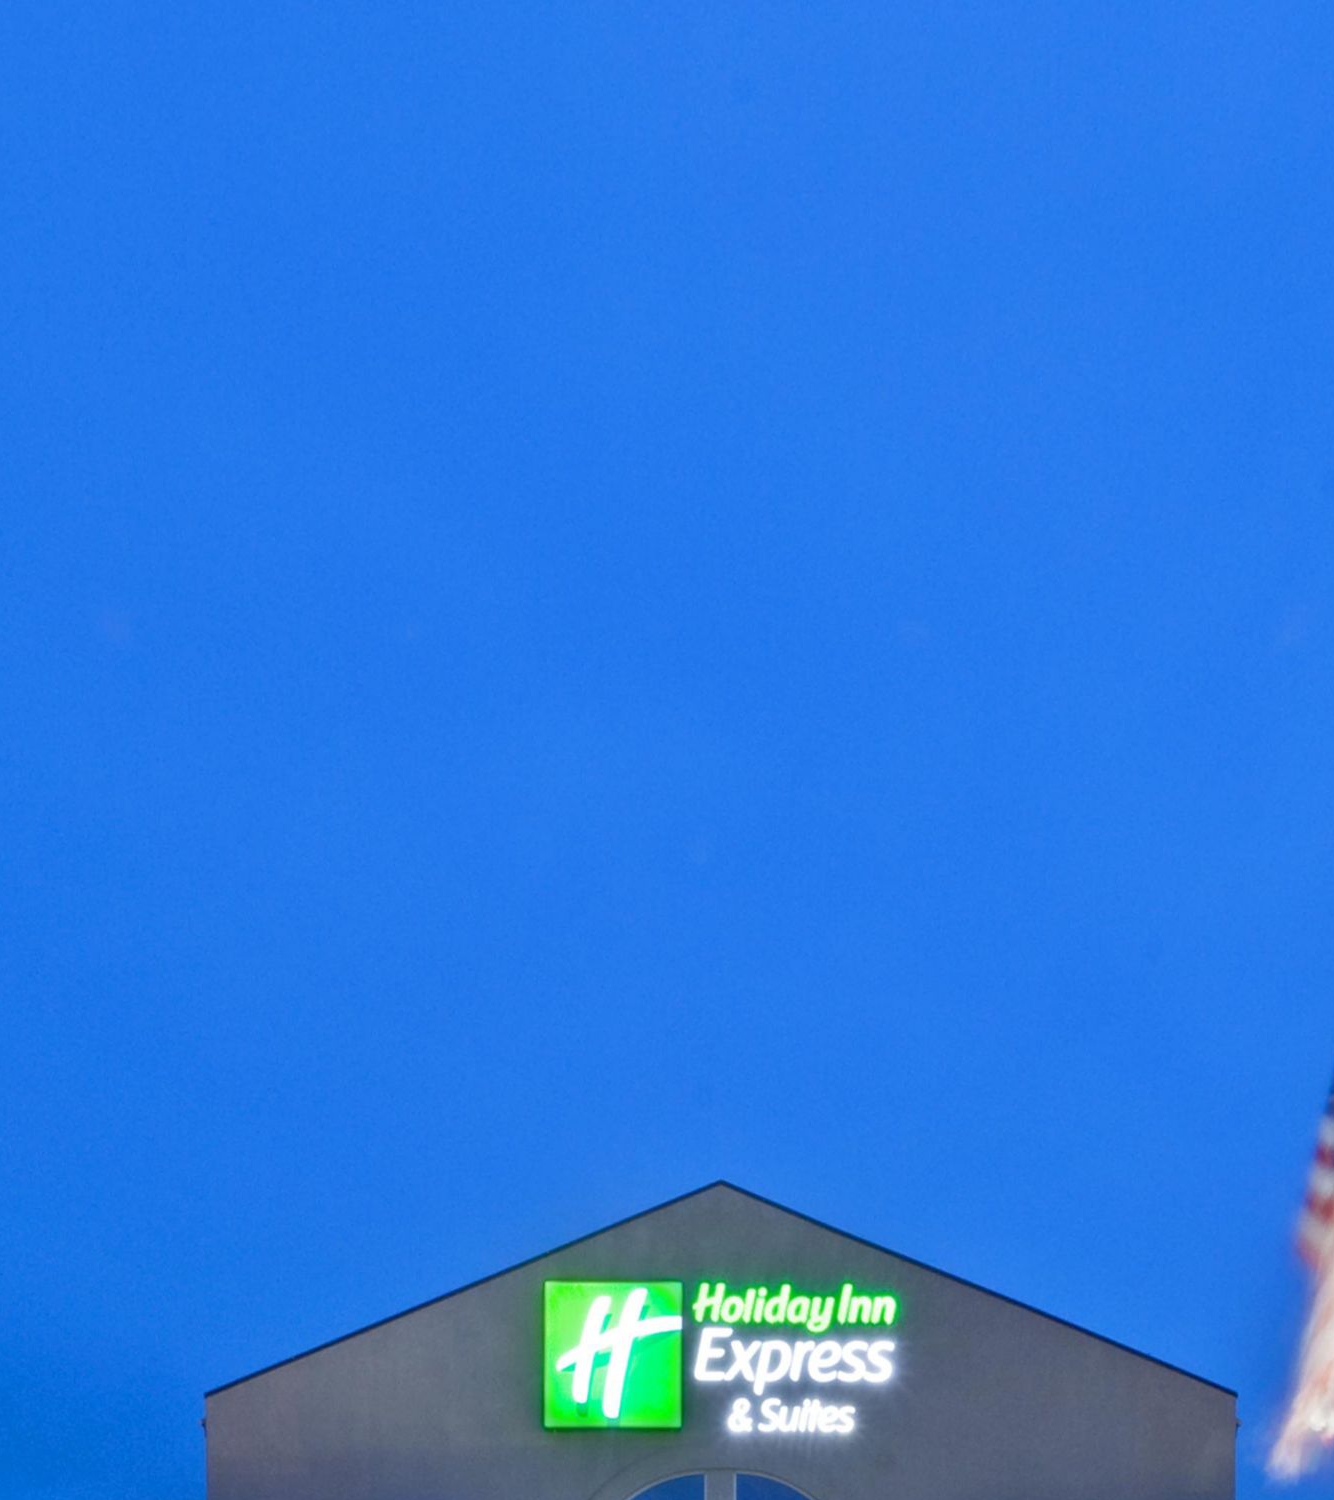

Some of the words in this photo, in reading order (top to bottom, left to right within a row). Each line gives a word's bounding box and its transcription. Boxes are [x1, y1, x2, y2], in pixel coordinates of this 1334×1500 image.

[692, 1282, 835, 1333] Holiday
[837, 1283, 897, 1325] Inn
[694, 1326, 895, 1396] Express
[727, 1397, 753, 1433] &
[757, 1397, 856, 1433] Suites
